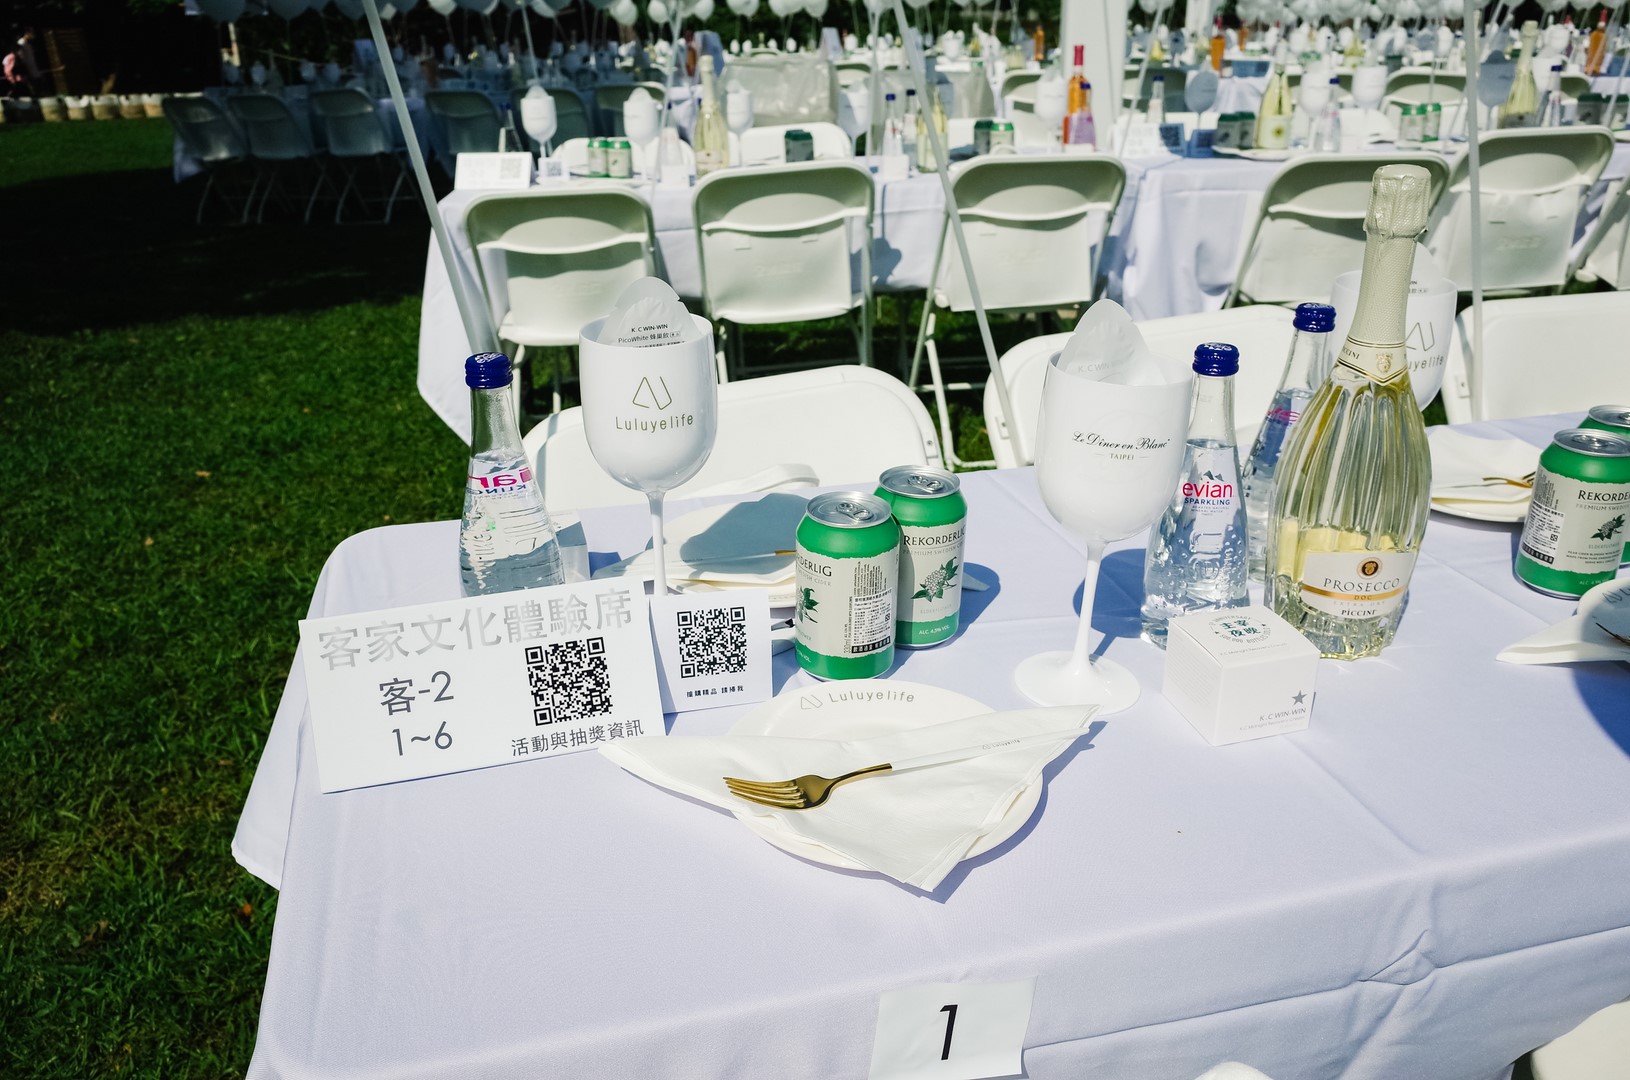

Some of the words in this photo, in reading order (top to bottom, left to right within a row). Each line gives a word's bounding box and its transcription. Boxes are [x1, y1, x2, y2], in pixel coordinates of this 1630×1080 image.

[618, 335, 649, 344] PicoWhite
[616, 413, 694, 433] Luluyelife
[1072, 430, 1085, 442] Le
[1182, 481, 1233, 498] evian
[1578, 489, 1630, 501] REKORDE
[1184, 497, 1230, 505] SPARKLING
[1576, 503, 1607, 511] PREMIUM
[1323, 578, 1400, 592] PROSECCO
[318, 587, 632, 671] 客家文化體驗席
[379, 670, 454, 715] 客-2
[828, 690, 915, 702] Luluyelife
[1274, 707, 1307, 719] WIN-WIN
[392, 721, 453, 756] 1~6
[511, 719, 645, 757] 活動與抽獎資訊
[940, 1004, 958, 1060] 1
